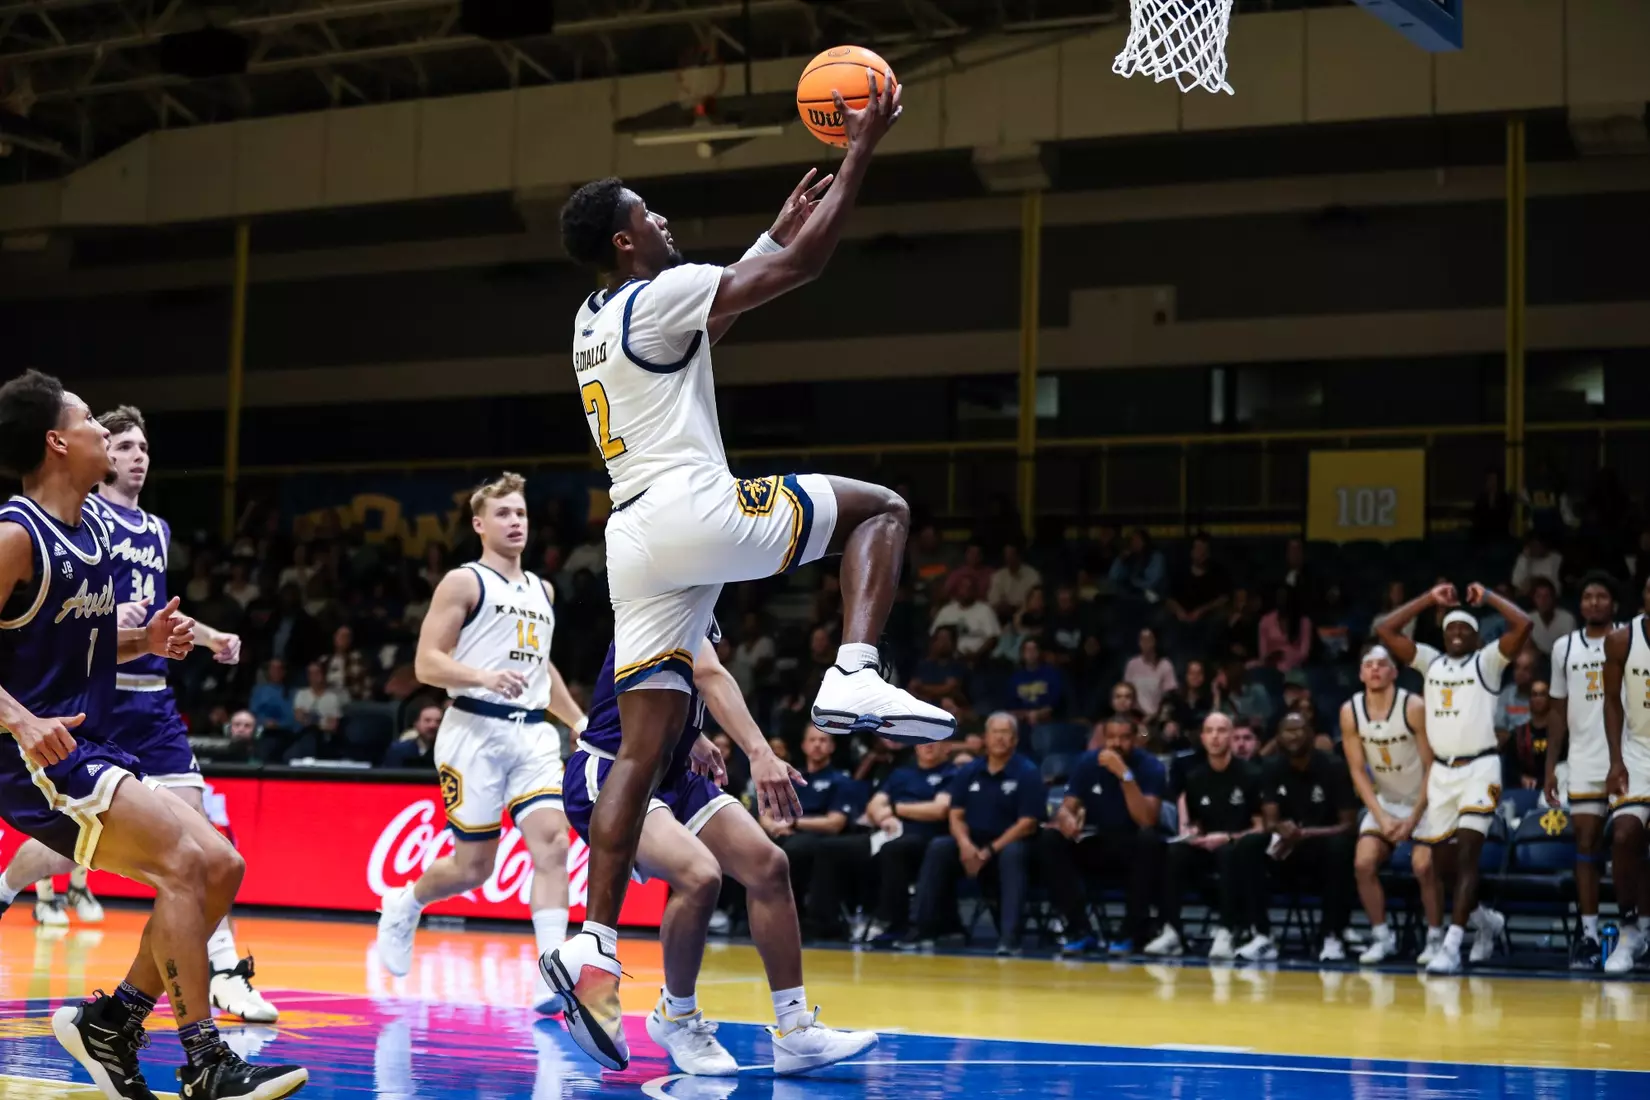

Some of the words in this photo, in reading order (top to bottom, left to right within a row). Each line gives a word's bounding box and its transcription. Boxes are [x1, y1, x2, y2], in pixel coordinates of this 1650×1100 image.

[807, 108, 844, 128] Wil
[576, 341, 607, 372] B.DIALLO
[581, 379, 628, 461] 2
[1336, 488, 1397, 527] 102
[61, 560, 74, 575] JB
[110, 536, 164, 574] Avila
[54, 574, 115, 624] Avil
[130, 570, 156, 606] 34
[495, 604, 551, 626] KANSAS
[516, 619, 540, 651] 14
[87, 628, 98, 677] 1
[509, 650, 543, 666] CITY
[1572, 661, 1606, 671] KAN
[1585, 671, 1605, 692] 2
[1585, 692, 1605, 701] CIT
